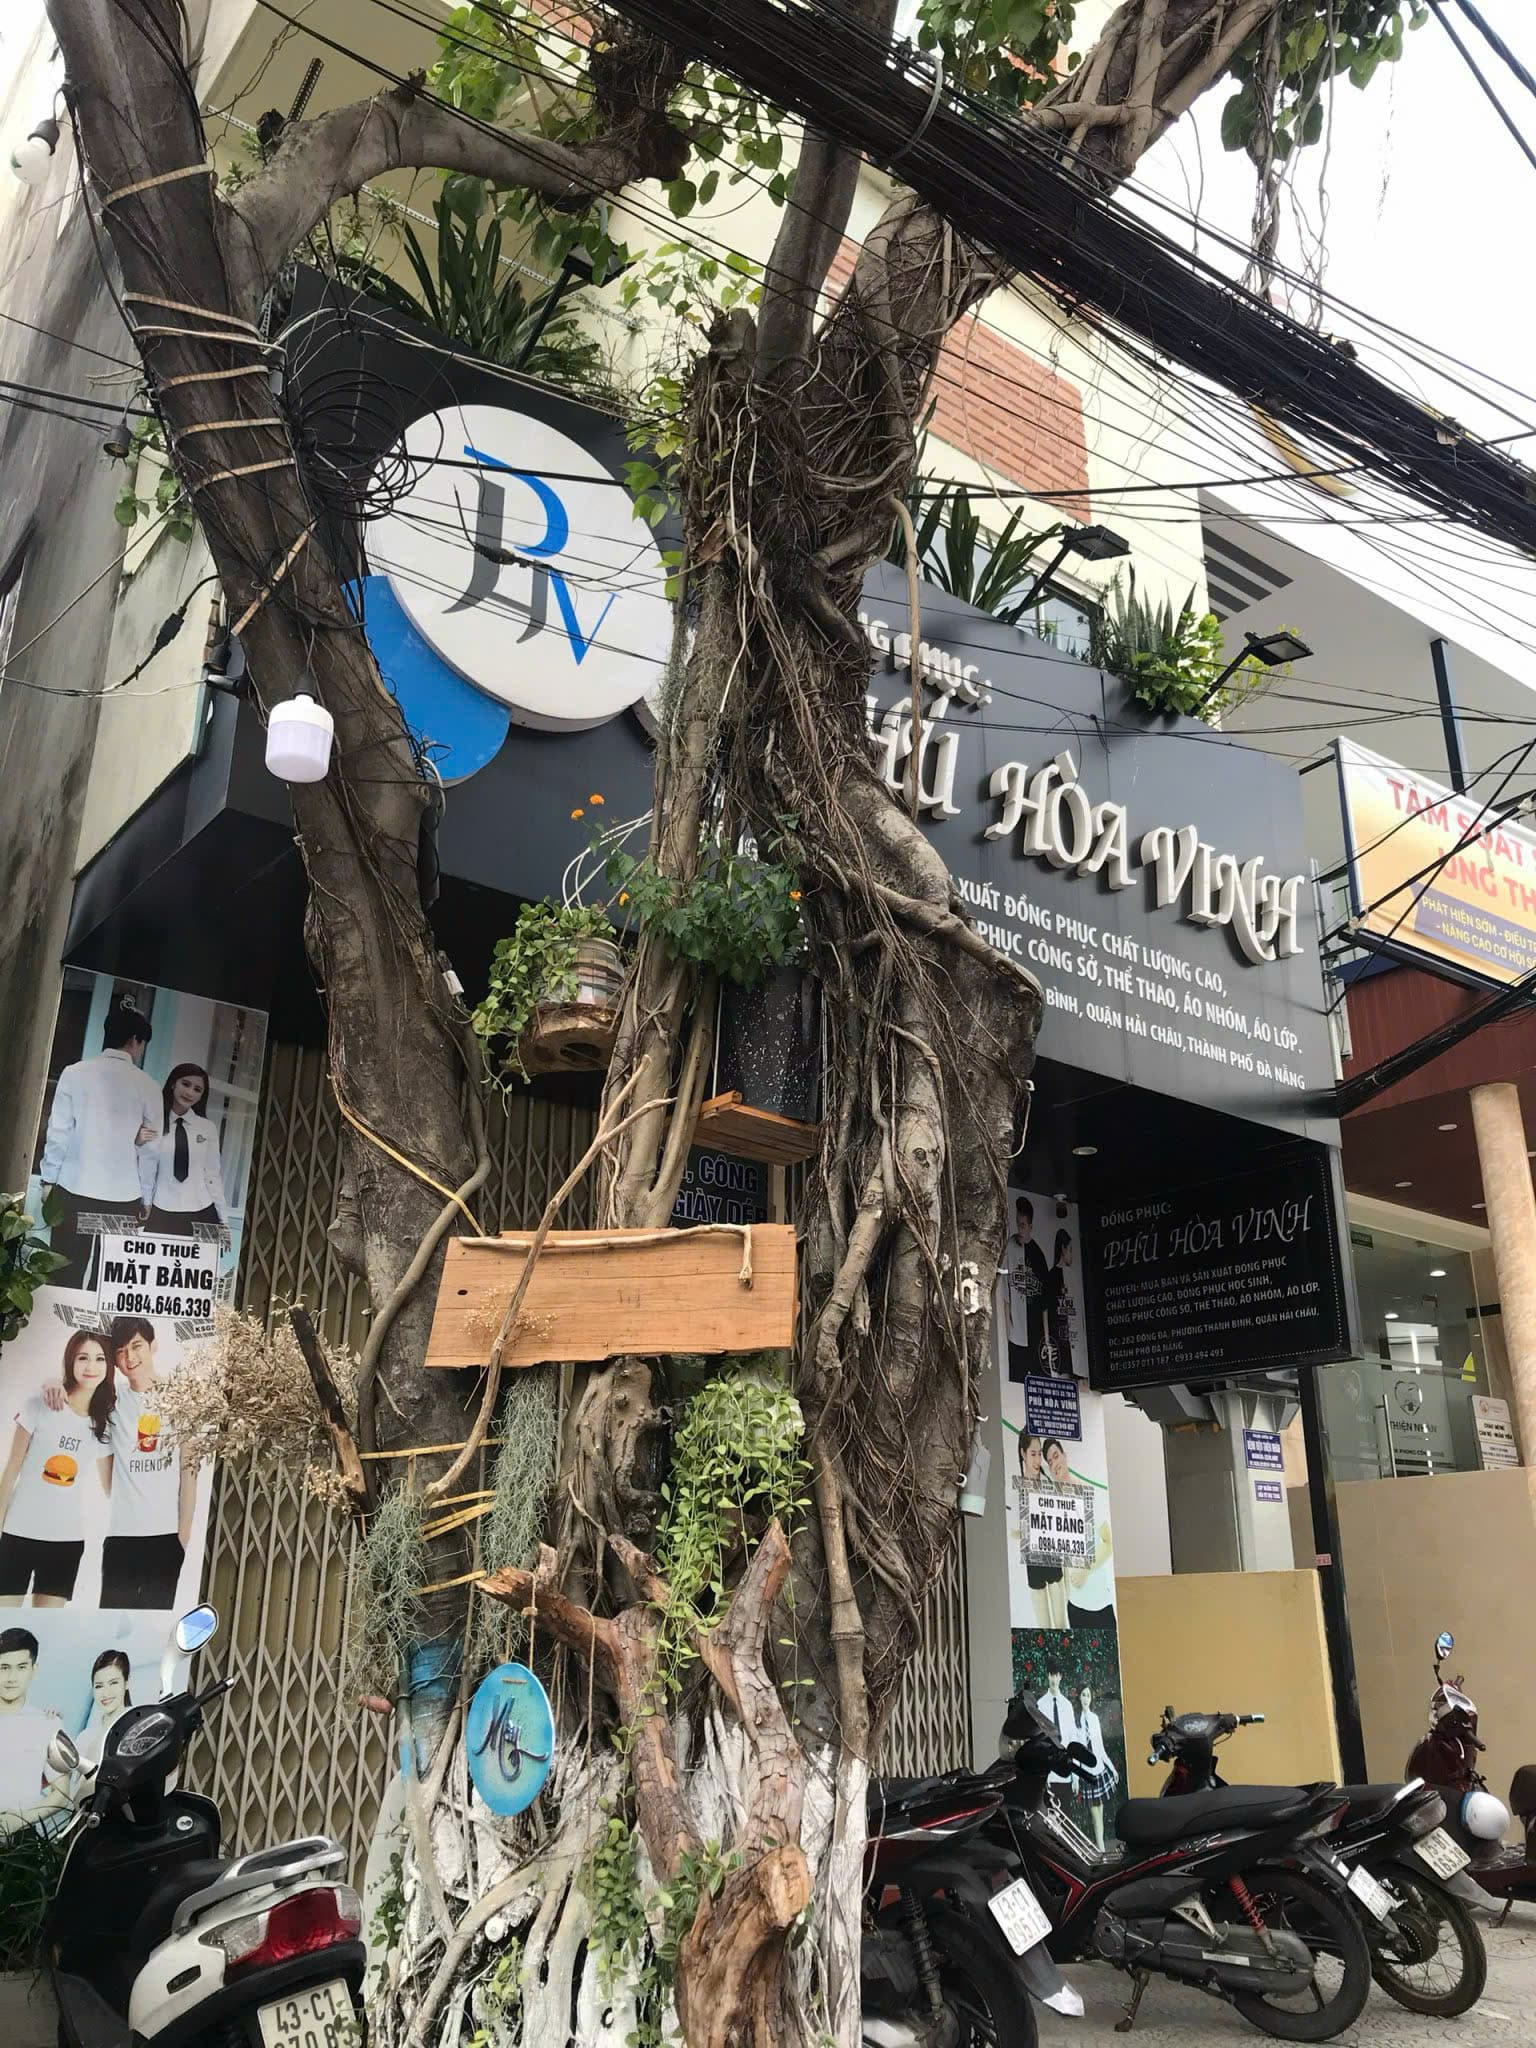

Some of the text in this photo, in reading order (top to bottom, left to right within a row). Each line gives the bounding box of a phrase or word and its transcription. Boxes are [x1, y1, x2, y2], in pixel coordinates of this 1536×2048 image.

[984, 748, 1137, 891] HÒA
[1140, 824, 1305, 965] VINH
[1502, 876, 1536, 913] TH
[1422, 896, 1448, 916] PHÁT
[1450, 907, 1473, 928] HIỆN
[958, 877, 1227, 998] XUẤT ĐỒNG PHỤC CHẤT LƯỢNG CAO,
[1442, 921, 1470, 944] NÂNG
[1472, 935, 1492, 953] CAO
[1493, 944, 1507, 958] CƠ
[1508, 949, 1526, 968] HỘI
[977, 920, 1022, 957] PHỤC
[1028, 938, 1072, 973] CÔNG
[1077, 954, 1102, 986] SỞ,
[1104, 965, 1134, 994] THỂ
[1136, 977, 1180, 1013] THAO,
[1183, 991, 1202, 1017] ÁO
[1206, 1001, 1251, 1040] NHÓM,
[1254, 1017, 1271, 1042] ÁO
[1045, 986, 1306, 1089] BÌNH, QUẬN HẢI CHÂU, THÀNH PHỐ ĐÀ NẴNG
[699, 1154, 758, 1194] CÔNG
[671, 1187, 723, 1224] GIÀY
[1136, 1201, 1172, 1220] PHỤC:
[1103, 1194, 1314, 1270] PHÚ HÒA VINH
[124, 1240, 200, 1259] CHO THUÊ
[104, 1258, 214, 1291] MẶT BẰNG
[1248, 1274, 1273, 1288] SINH,
[1286, 1284, 1299, 1298] ÁO
[116, 1292, 211, 1318] 0984.646.339
[59, 1435, 81, 1452] BEST
[1038, 1497, 1076, 1511] CHO THUÊ
[1030, 1511, 1084, 1534] MẶT BẰNG
[1038, 1536, 1085, 1555] 0984.646.339
[276, 1988, 336, 2034] 43-C1
